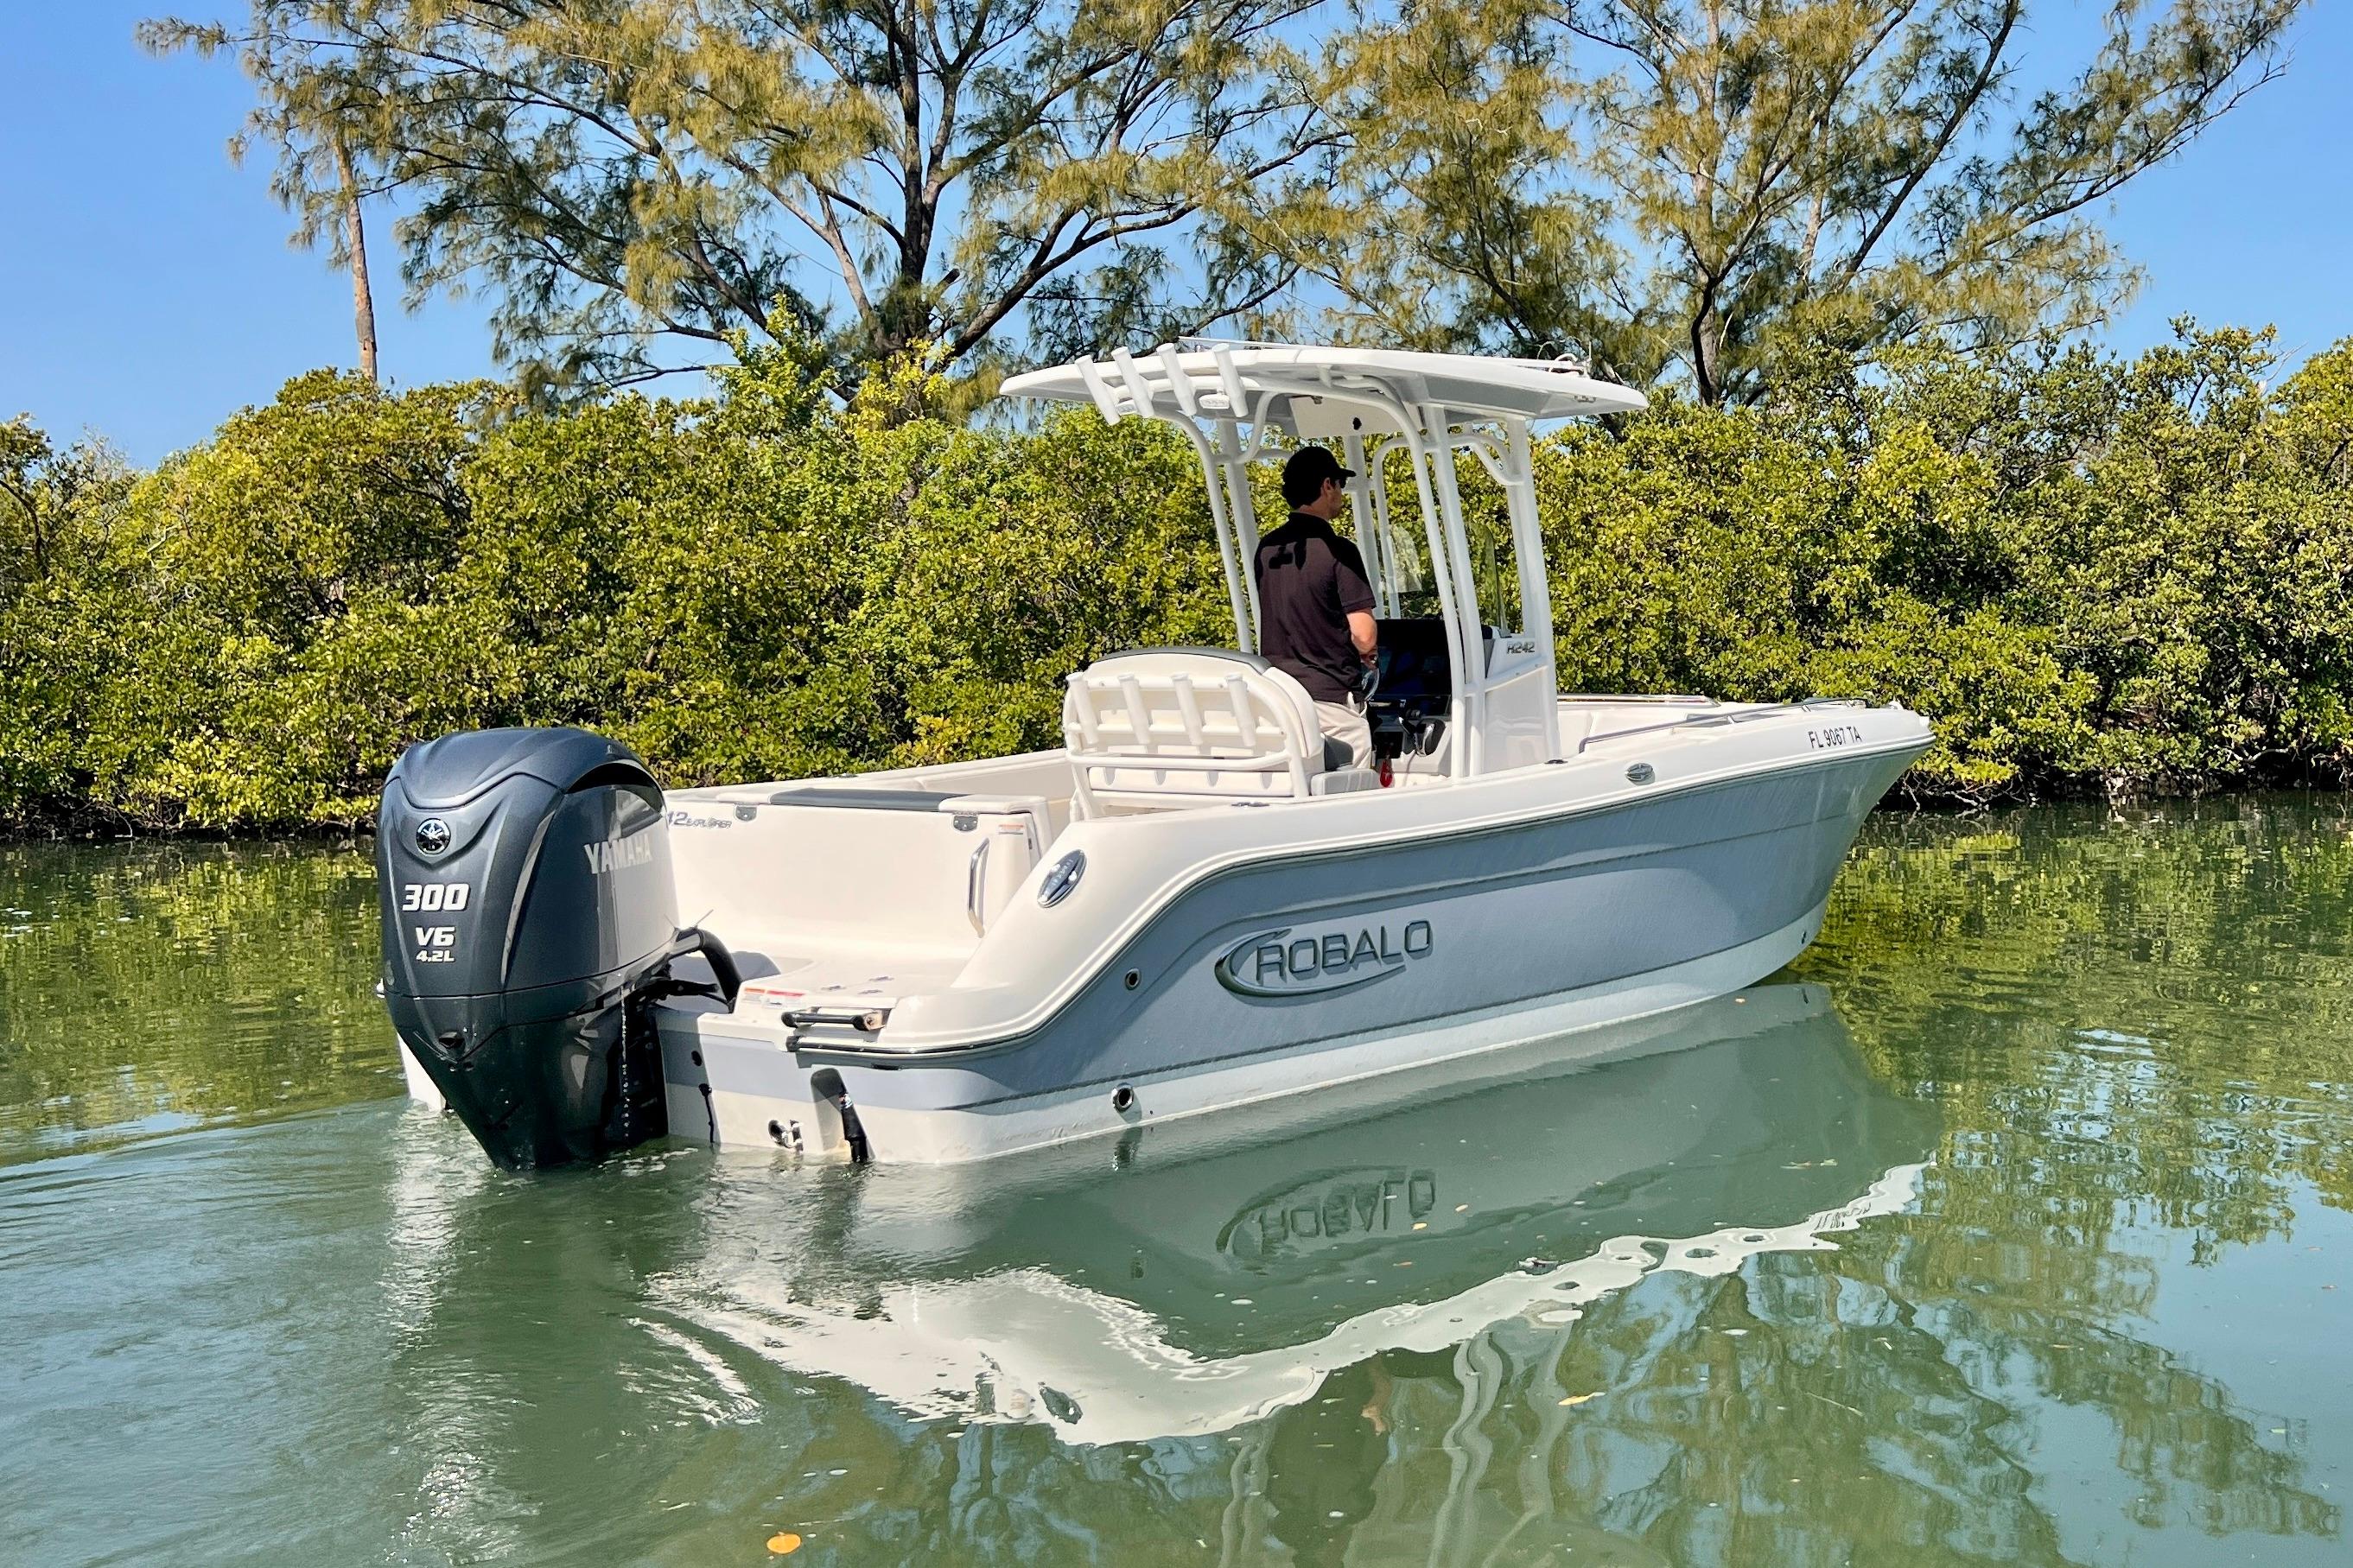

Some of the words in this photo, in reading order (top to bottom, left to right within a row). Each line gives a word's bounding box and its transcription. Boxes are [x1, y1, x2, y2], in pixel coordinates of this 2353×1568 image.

[1808, 730, 1824, 749] FL
[1823, 727, 1846, 747] 9067
[1846, 726, 1862, 744] TA
[583, 833, 652, 874] YAMAHA
[402, 883, 470, 911] 300
[415, 926, 455, 947] V6
[416, 949, 455, 962] 4.2L
[1256, 920, 1434, 987] ROBALO
